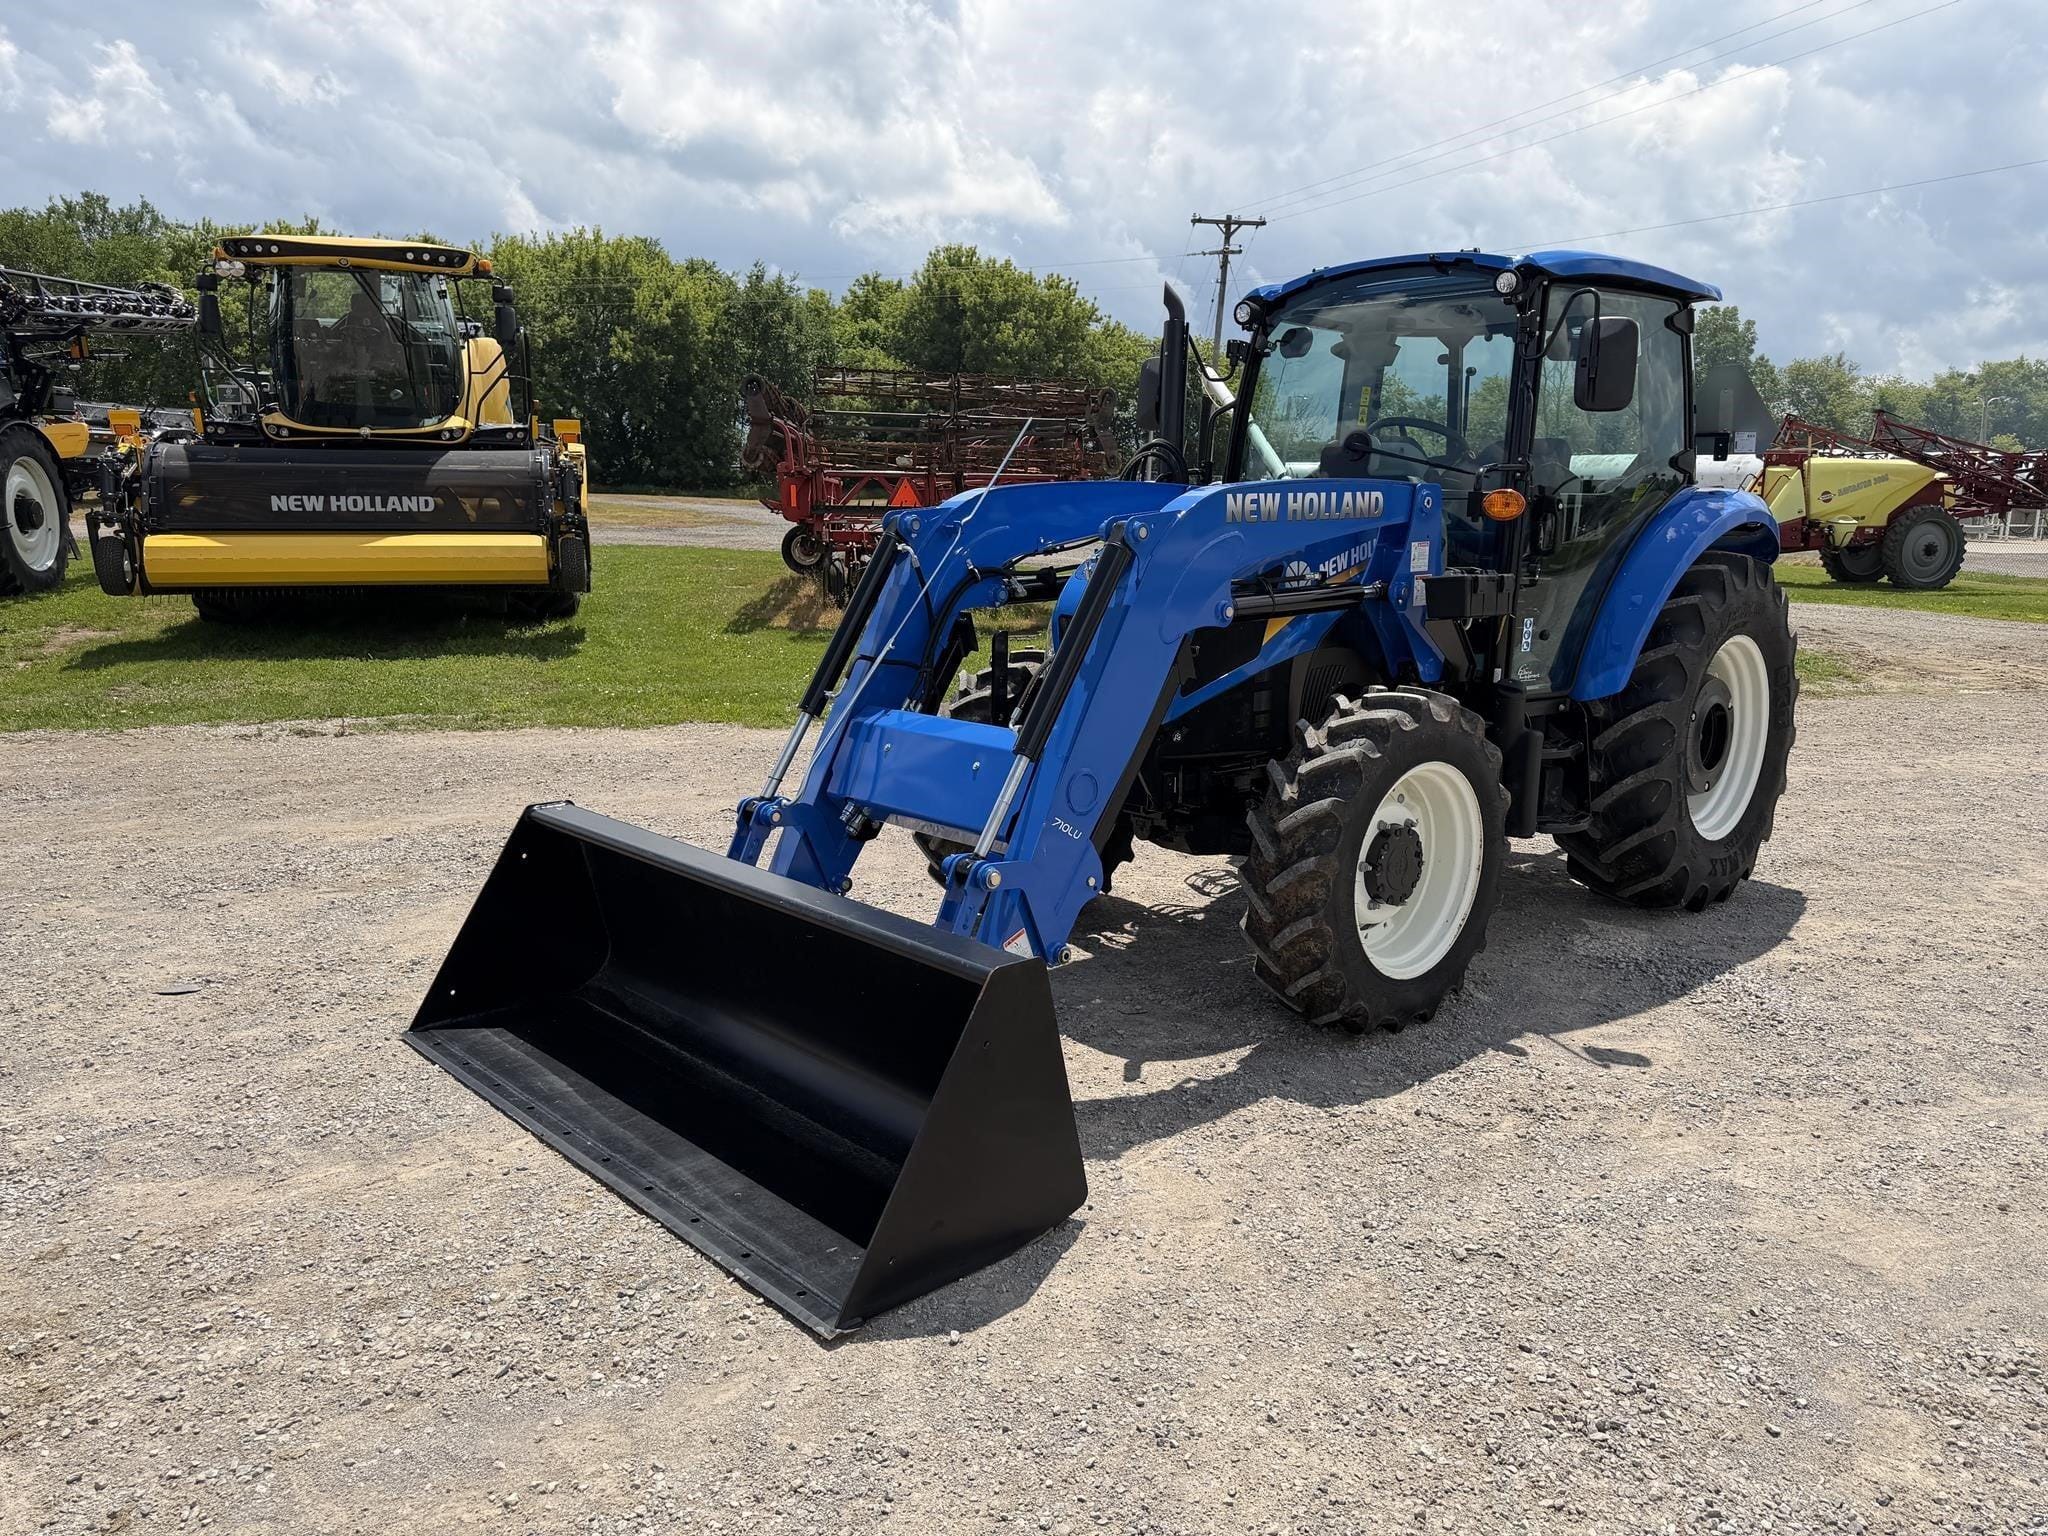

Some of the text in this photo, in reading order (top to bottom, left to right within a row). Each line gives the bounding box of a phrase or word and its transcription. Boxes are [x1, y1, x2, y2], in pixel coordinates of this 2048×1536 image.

[271, 495, 435, 512] NEW HOLLAND
[1225, 491, 1384, 523] NEW HOLLAND
[1319, 550, 1349, 578] NEW
[1350, 538, 1377, 567] HOL
[1051, 816, 1083, 840] 710LU
